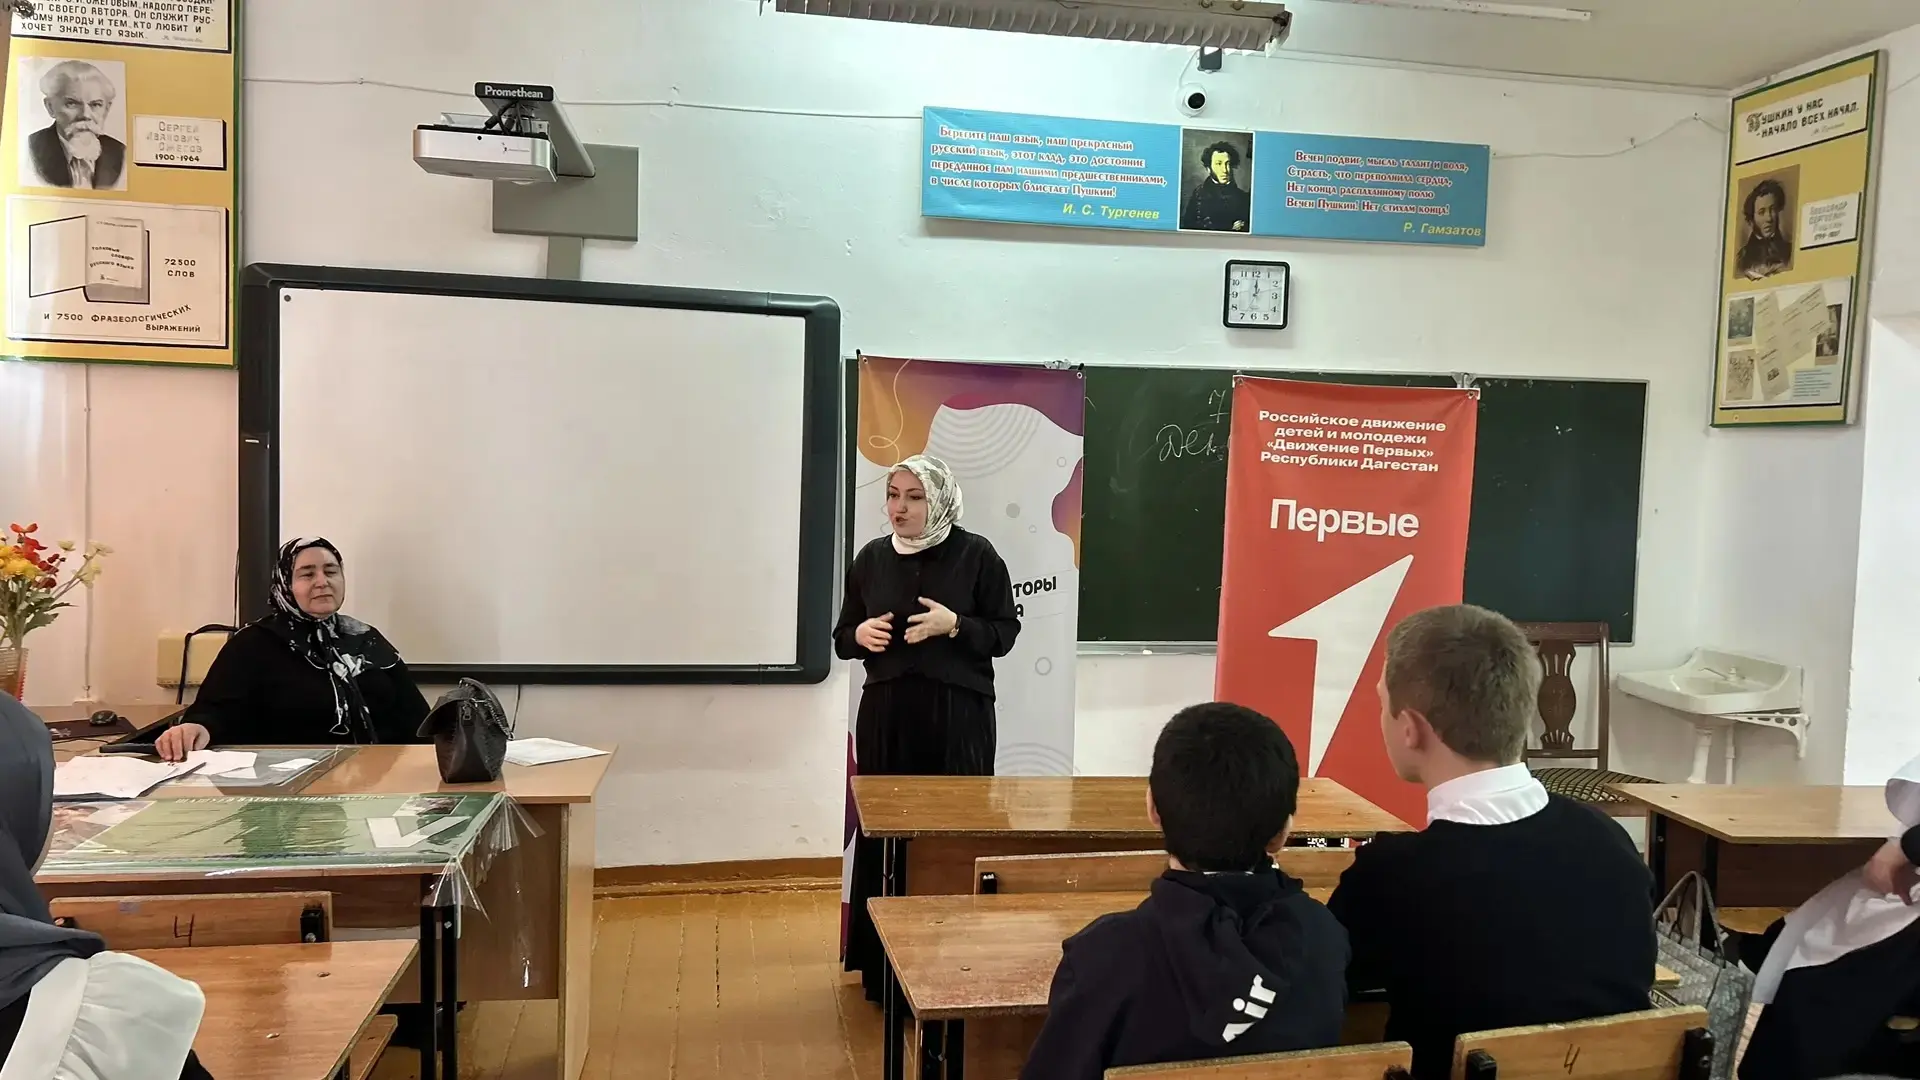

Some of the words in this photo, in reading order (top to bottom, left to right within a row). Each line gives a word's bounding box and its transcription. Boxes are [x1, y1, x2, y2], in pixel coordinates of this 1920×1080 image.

[49, 4, 87, 14] СВОЕГО
[134, 9, 147, 18] ОН
[150, 11, 189, 22] СЛУЖИТ
[143, 2, 184, 12] НАДОЛГО
[21, 22, 53, 31] ХОЧЕТ
[60, 25, 90, 34] ЗНАТЬ
[94, 28, 112, 36] ЕГО
[57, 16, 94, 25] НАРОДУ
[133, 21, 152, 29] КТО
[156, 23, 188, 32] ЛЮБИТ
[484, 84, 544, 99] Promethean
[1796, 103, 1803, 114] У
[1806, 98, 1824, 112] НАС
[1802, 112, 1825, 127] ВСЕХ
[940, 126, 985, 140] Берегите
[989, 133, 1011, 141] наш
[1014, 136, 1043, 146] язык,
[1046, 138, 1067, 146] наш
[1071, 139, 1134, 151] прекрасный
[931, 144, 976, 155] русский
[979, 148, 1008, 159] язык,
[1012, 151, 1035, 160] этот
[1038, 153, 1066, 164] клад,
[1069, 155, 1088, 163] это
[1090, 157, 1145, 168] достояние
[1296, 151, 1324, 162] Вечен
[1326, 155, 1364, 167] подвиг,
[1367, 158, 1398, 166] мысль
[1400, 159, 1431, 168] талант
[1433, 161, 1441, 169] и
[1442, 162, 1469, 173] воля,
[931, 160, 991, 174] переданное
[994, 165, 1014, 174] нам
[1017, 168, 1058, 177] нашими
[1061, 171, 1168, 186] предшественниками,
[1288, 166, 1332, 180] Страсть,
[1335, 171, 1352, 179] что
[1354, 172, 1413, 183] переполнила
[1416, 176, 1453, 187] сердца,
[931, 177, 938, 185] в
[941, 178, 971, 187] числе
[974, 181, 1020, 192] которых
[1023, 181, 1069, 194] блистает
[1072, 184, 1117, 198] Пушкин!
[1287, 181, 1305, 192] Нет
[1308, 185, 1337, 196] конца
[1340, 187, 1406, 200] распаханному
[1408, 190, 1435, 199] полю
[1062, 202, 1076, 215] И.
[1081, 204, 1095, 216] С.
[1101, 205, 1160, 220] Тургенев
[1287, 197, 1315, 208] Вечен
[1362, 200, 1379, 211] Нет
[1382, 204, 1416, 213] стихам
[1418, 203, 1450, 216] конца!
[1403, 222, 1416, 234] Р.
[1421, 223, 1482, 237] Гамзатов
[164, 258, 196, 267] 72500
[167, 269, 196, 278] СЛОВ
[57, 313, 84, 321] 7500
[91, 303, 192, 324] ФРАЗЕОЛОГИЧЕСКИХ
[145, 323, 201, 333] ВЫРАЖЕНИЙ
[1259, 409, 1359, 427] Российское
[1361, 418, 1447, 432] движение
[1274, 425, 1324, 441] детей
[1326, 430, 1337, 440] и
[1340, 431, 1427, 445] молодежи
[1266, 439, 1360, 455] «Движение
[1362, 444, 1435, 459] Первых»
[1260, 451, 1358, 468] Республики
[1360, 456, 1440, 473] Дагестан
[1269, 498, 1420, 542] Первые
[1013, 576, 1057, 598] ТОРЫ
[1015, 603, 1025, 619] А
[174, 913, 195, 948] 4
[1563, 1043, 1581, 1076] 4
